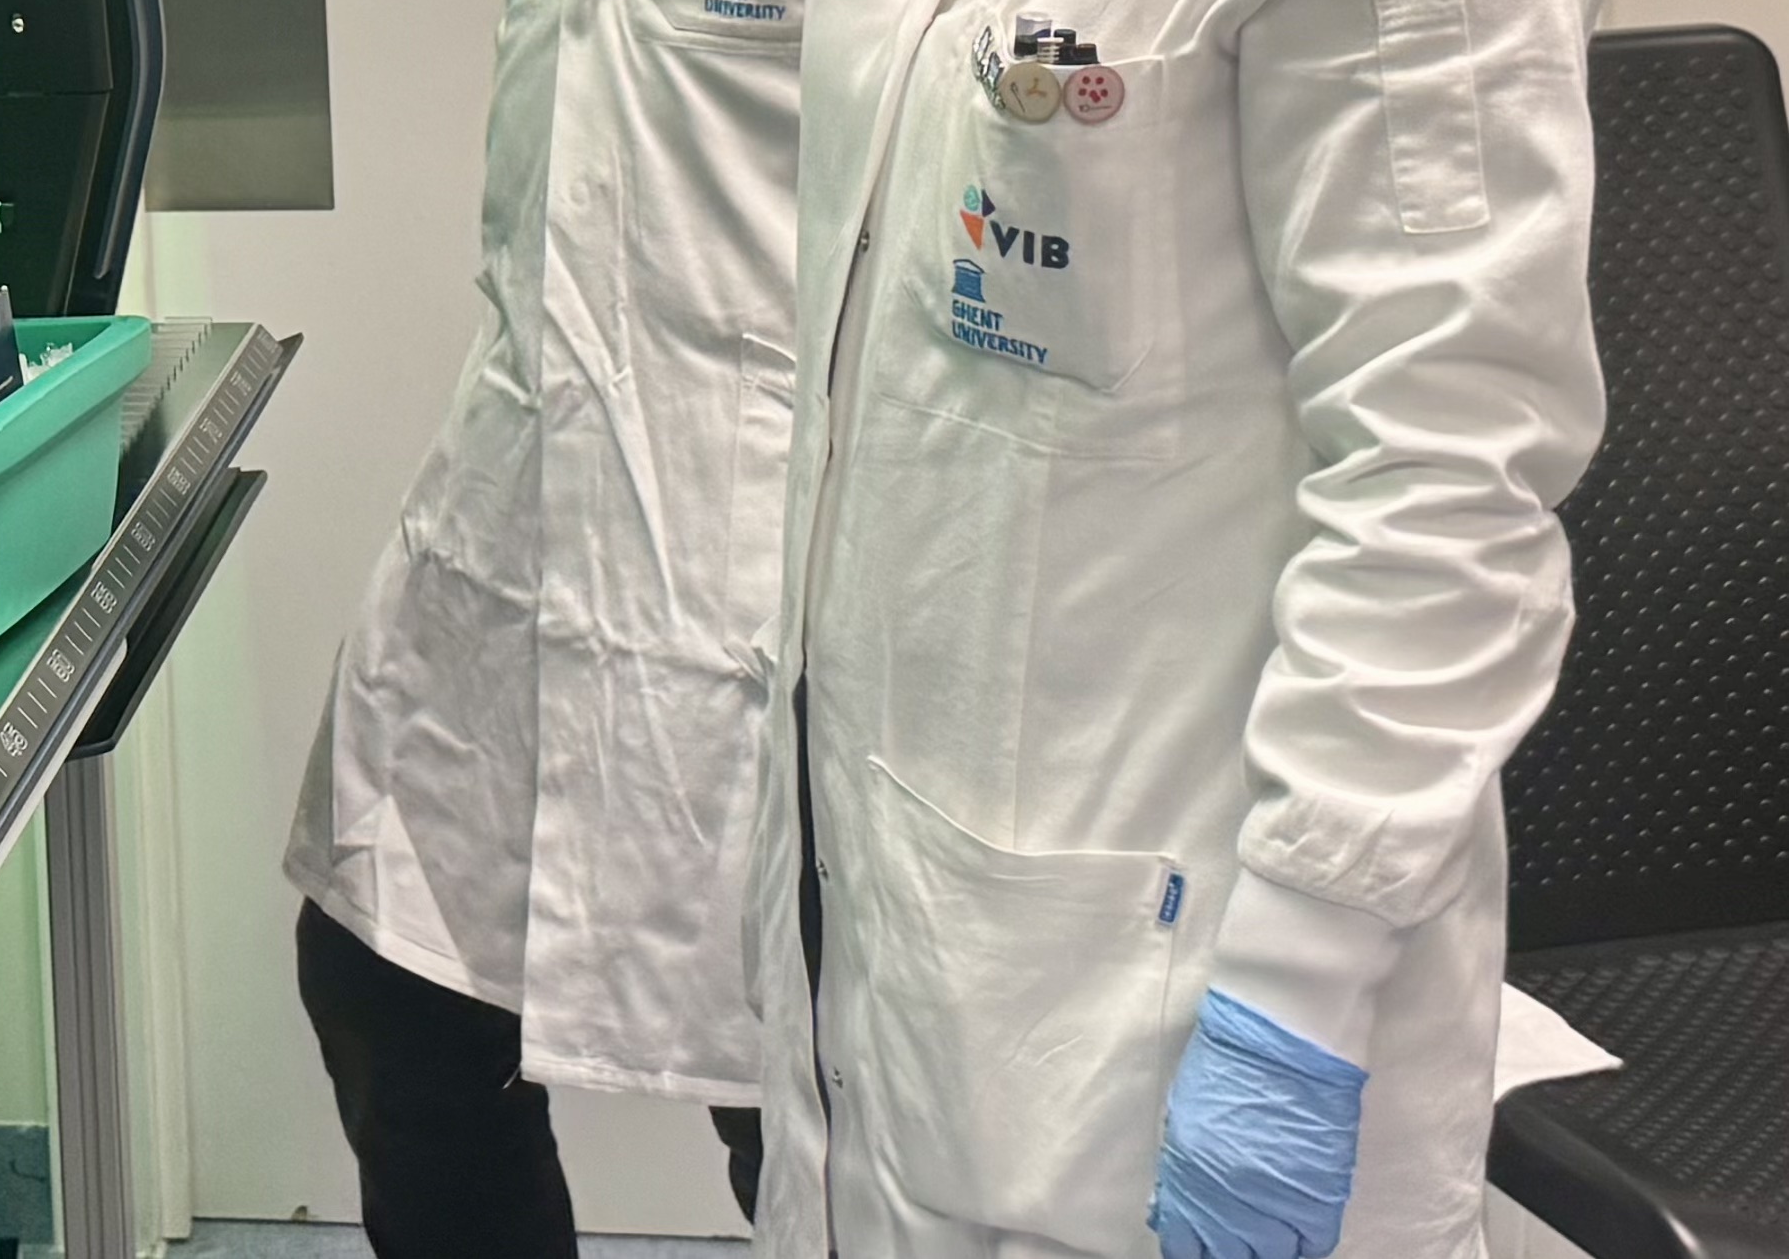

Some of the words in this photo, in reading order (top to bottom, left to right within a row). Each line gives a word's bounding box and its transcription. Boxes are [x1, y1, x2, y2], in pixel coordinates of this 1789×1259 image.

[989, 220, 1070, 269] VIB
[952, 299, 1004, 331] GHENT
[951, 319, 1048, 364] UNIVERSITY
[0, 721, 29, 757] 45
